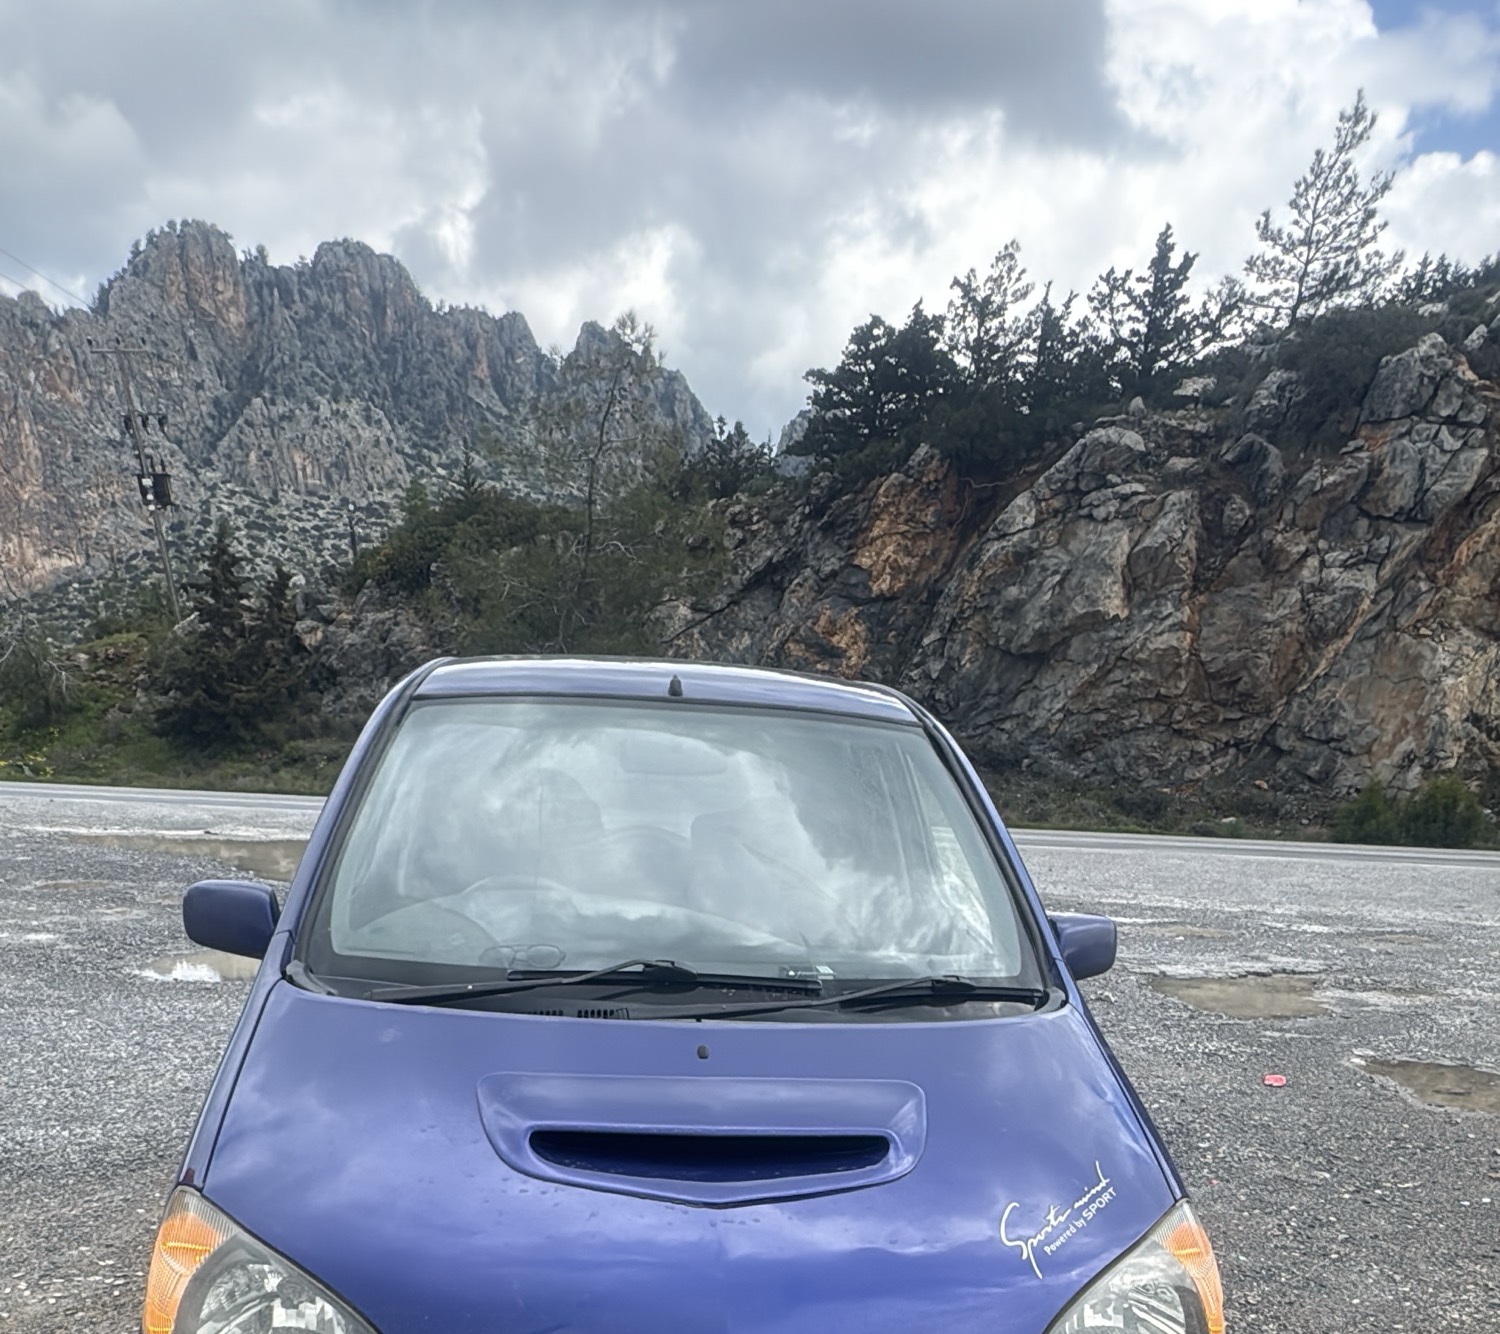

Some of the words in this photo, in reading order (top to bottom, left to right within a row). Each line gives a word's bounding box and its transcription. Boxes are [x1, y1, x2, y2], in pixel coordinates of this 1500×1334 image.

[1043, 1223, 1077, 1256] Powered
[1074, 1216, 1088, 1228] by
[1082, 1186, 1117, 1221] SPORT
